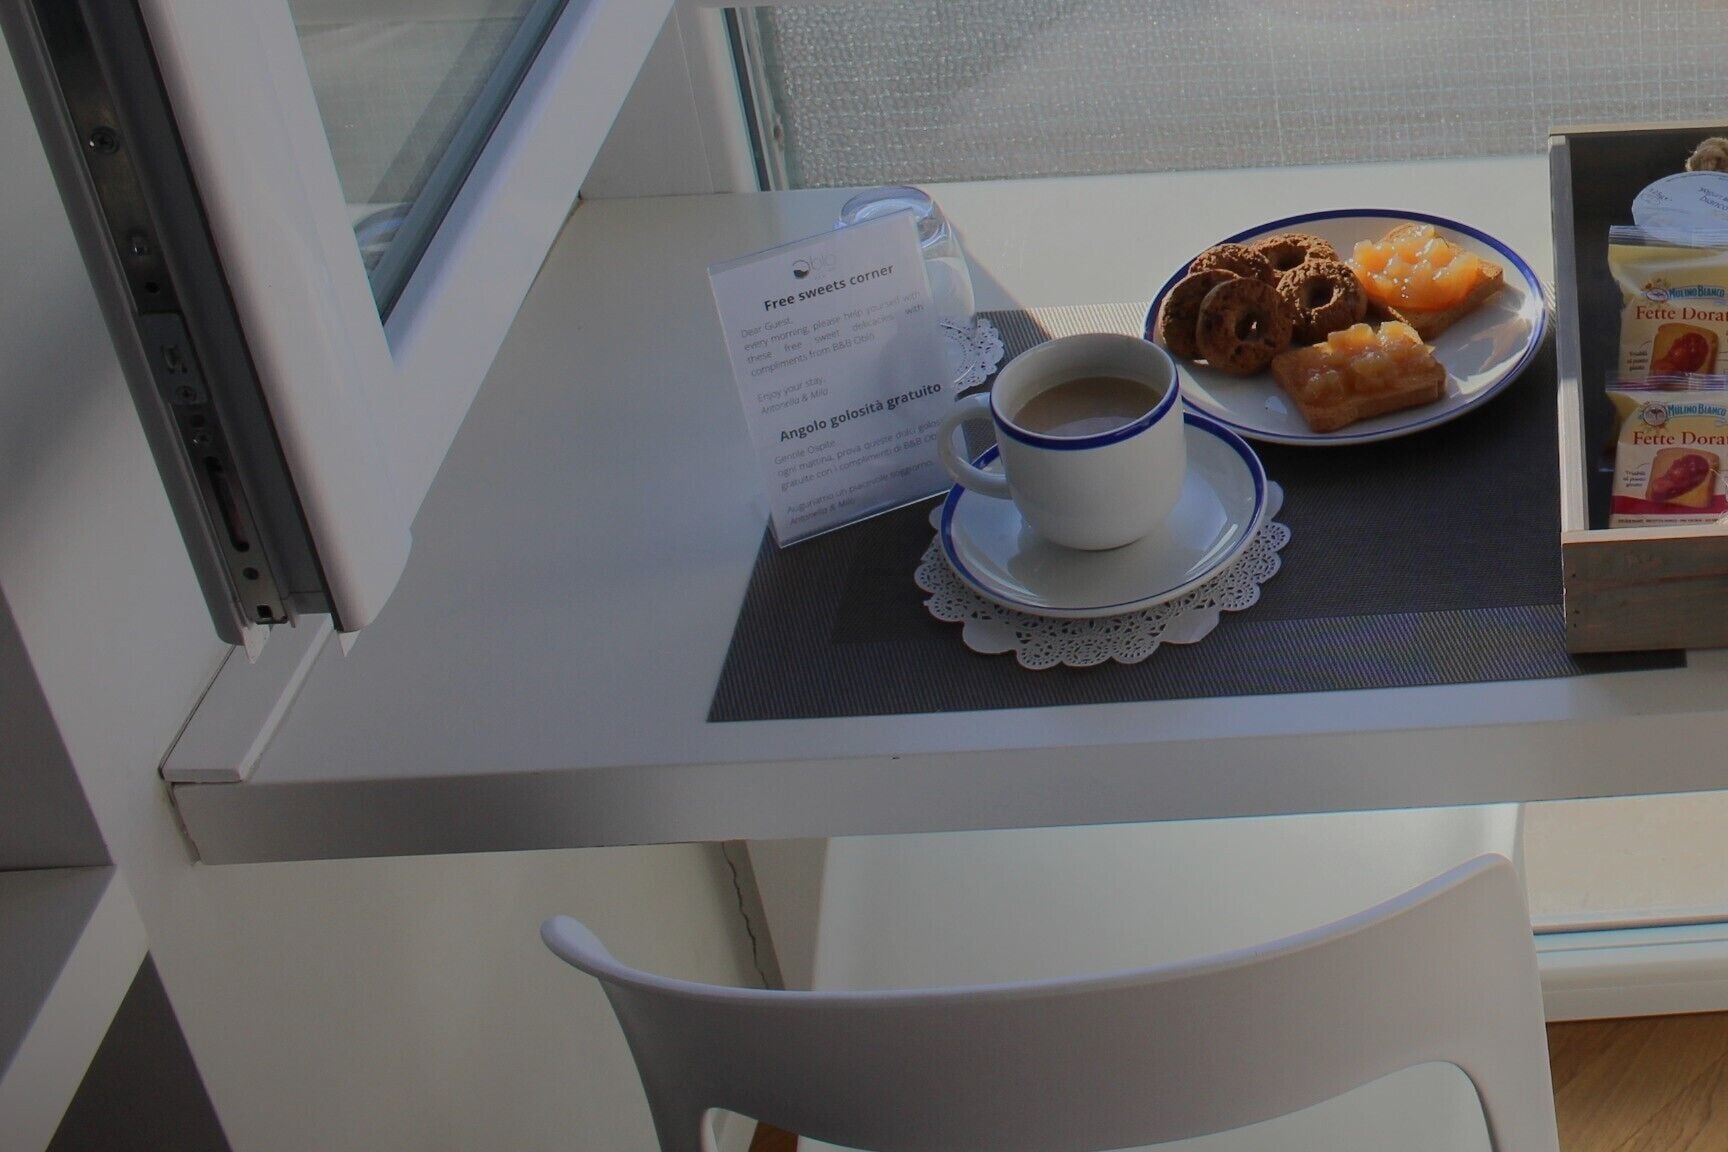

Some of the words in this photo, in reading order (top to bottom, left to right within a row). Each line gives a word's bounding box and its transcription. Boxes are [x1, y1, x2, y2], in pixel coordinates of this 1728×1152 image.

[764, 292, 795, 311] Free
[798, 279, 846, 301] sweets
[848, 264, 895, 285] corner
[904, 303, 923, 314] with
[1635, 305, 1676, 320] Fette
[741, 325, 761, 336] Dear
[779, 418, 828, 444] Angolo
[828, 399, 884, 428] golosità
[884, 381, 942, 409] gratuito
[1633, 431, 1675, 445] Fette
